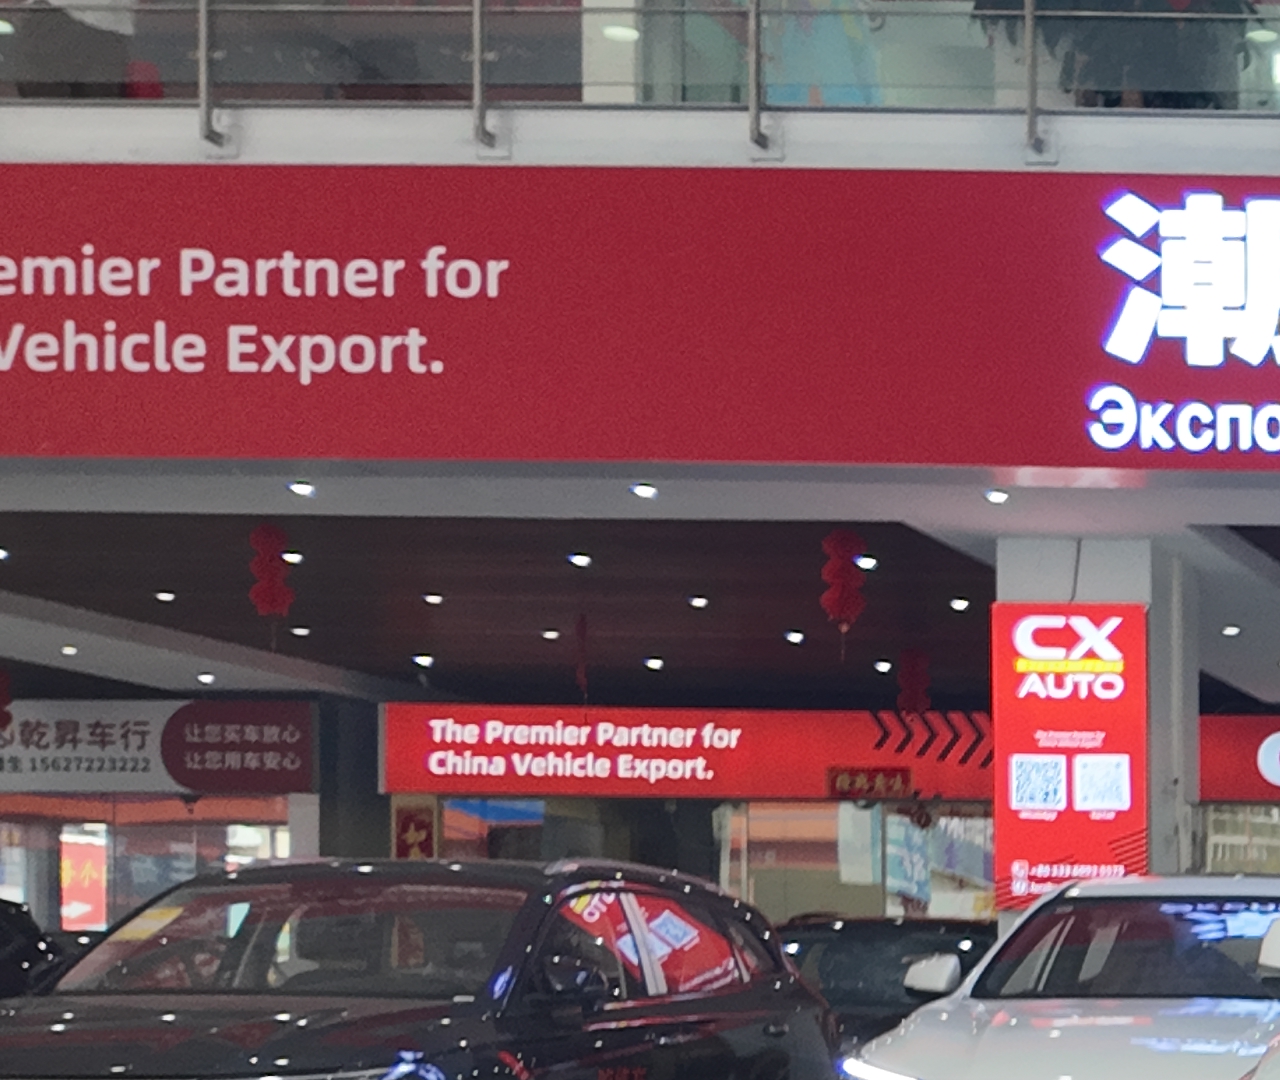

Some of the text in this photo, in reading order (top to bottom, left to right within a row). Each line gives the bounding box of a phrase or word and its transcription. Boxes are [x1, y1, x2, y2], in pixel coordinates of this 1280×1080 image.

[180, 247, 405, 298] Partner
[421, 245, 509, 299] for
[0, 320, 444, 386] Vehicle Export.
[1012, 614, 1124, 661] CX
[1016, 672, 1126, 700] AUTO
[428, 718, 742, 749] The Premier Partner for
[428, 750, 714, 784] China Vehicle Export.
